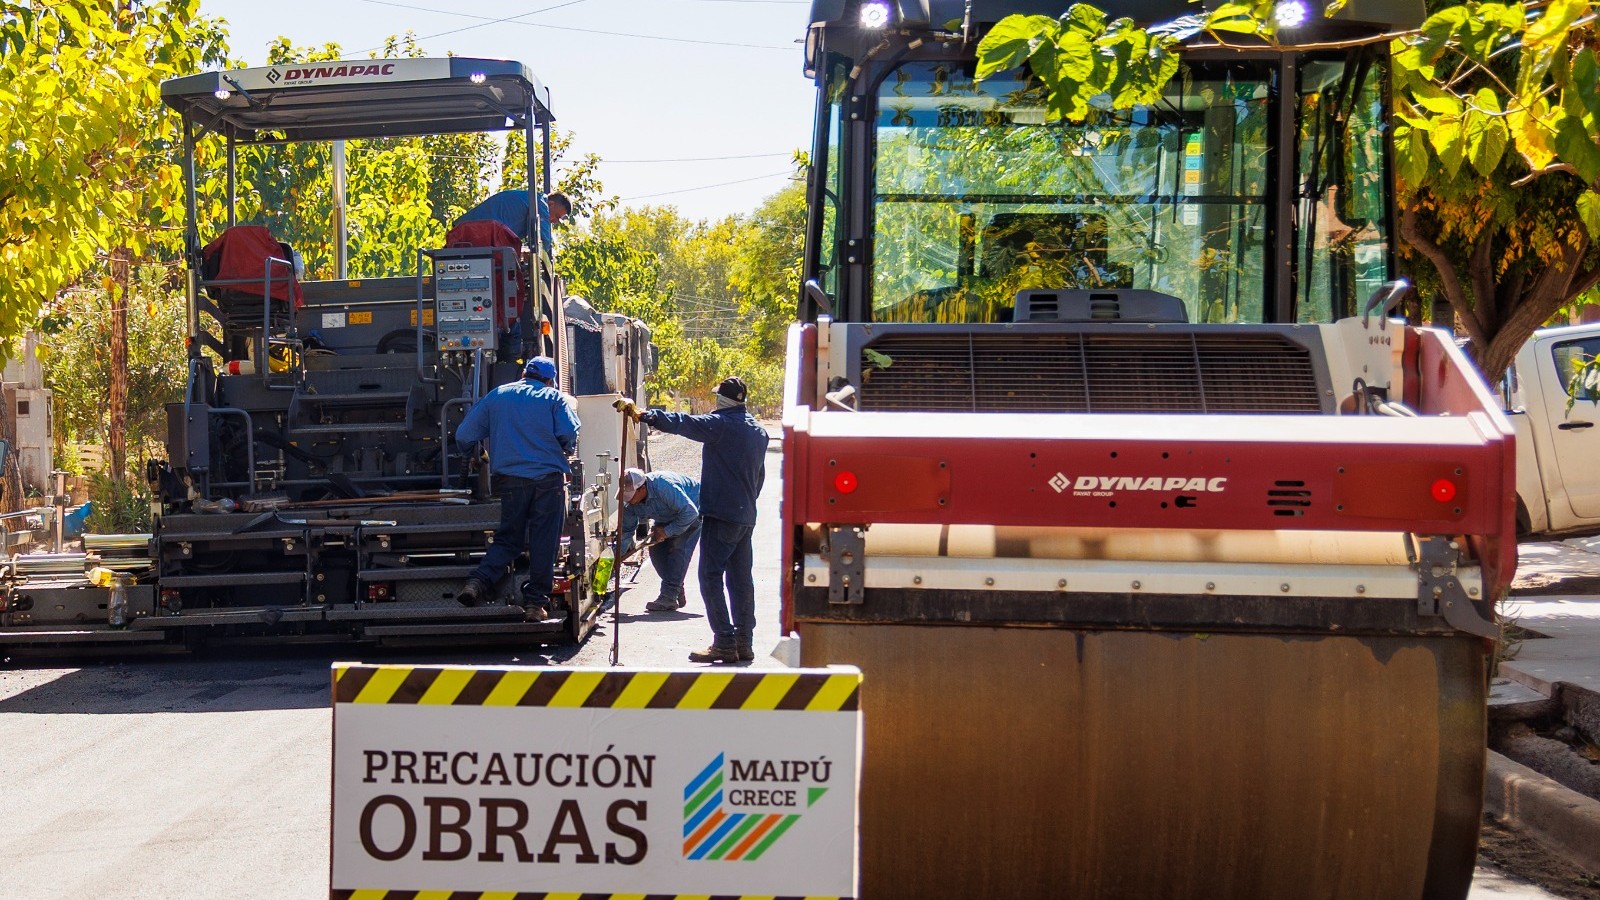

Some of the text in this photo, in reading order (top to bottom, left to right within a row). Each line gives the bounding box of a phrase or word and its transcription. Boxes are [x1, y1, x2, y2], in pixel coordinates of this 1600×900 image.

[284, 64, 395, 80] DYNAPAC
[1074, 476, 1227, 492] DYNAPAC
[363, 744, 656, 788] PRECAUCIÓN
[729, 756, 832, 782] MAIPÚ
[729, 789, 797, 806] CRECE
[359, 795, 648, 865] OBRAS
